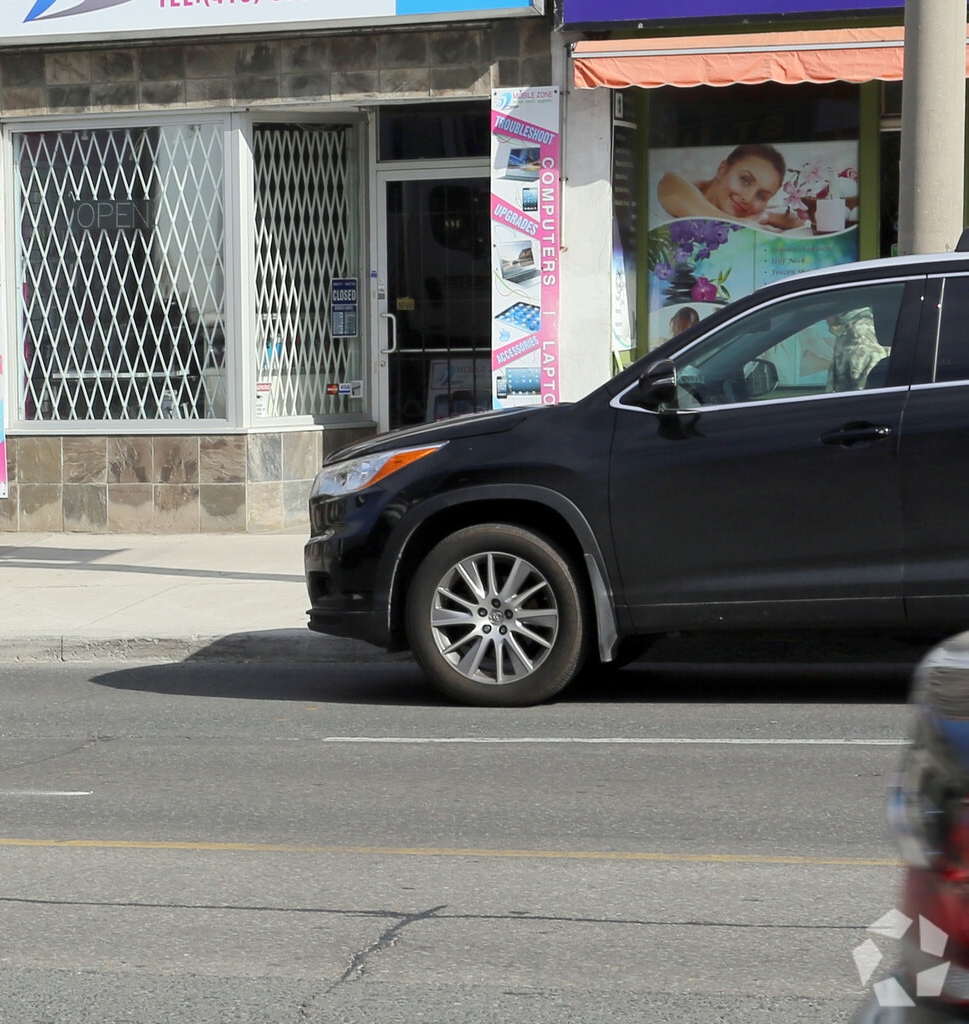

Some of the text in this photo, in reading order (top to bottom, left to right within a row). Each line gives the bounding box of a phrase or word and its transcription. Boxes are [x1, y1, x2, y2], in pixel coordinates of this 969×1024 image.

[495, 115, 555, 146] TROUBLESHOOT
[77, 202, 149, 228] OPEN
[493, 203, 539, 236] UPGRADES
[542, 157, 556, 286] COMPUTERS
[333, 289, 356, 301] CLOSED
[496, 336, 540, 364] ACCESSORIES
